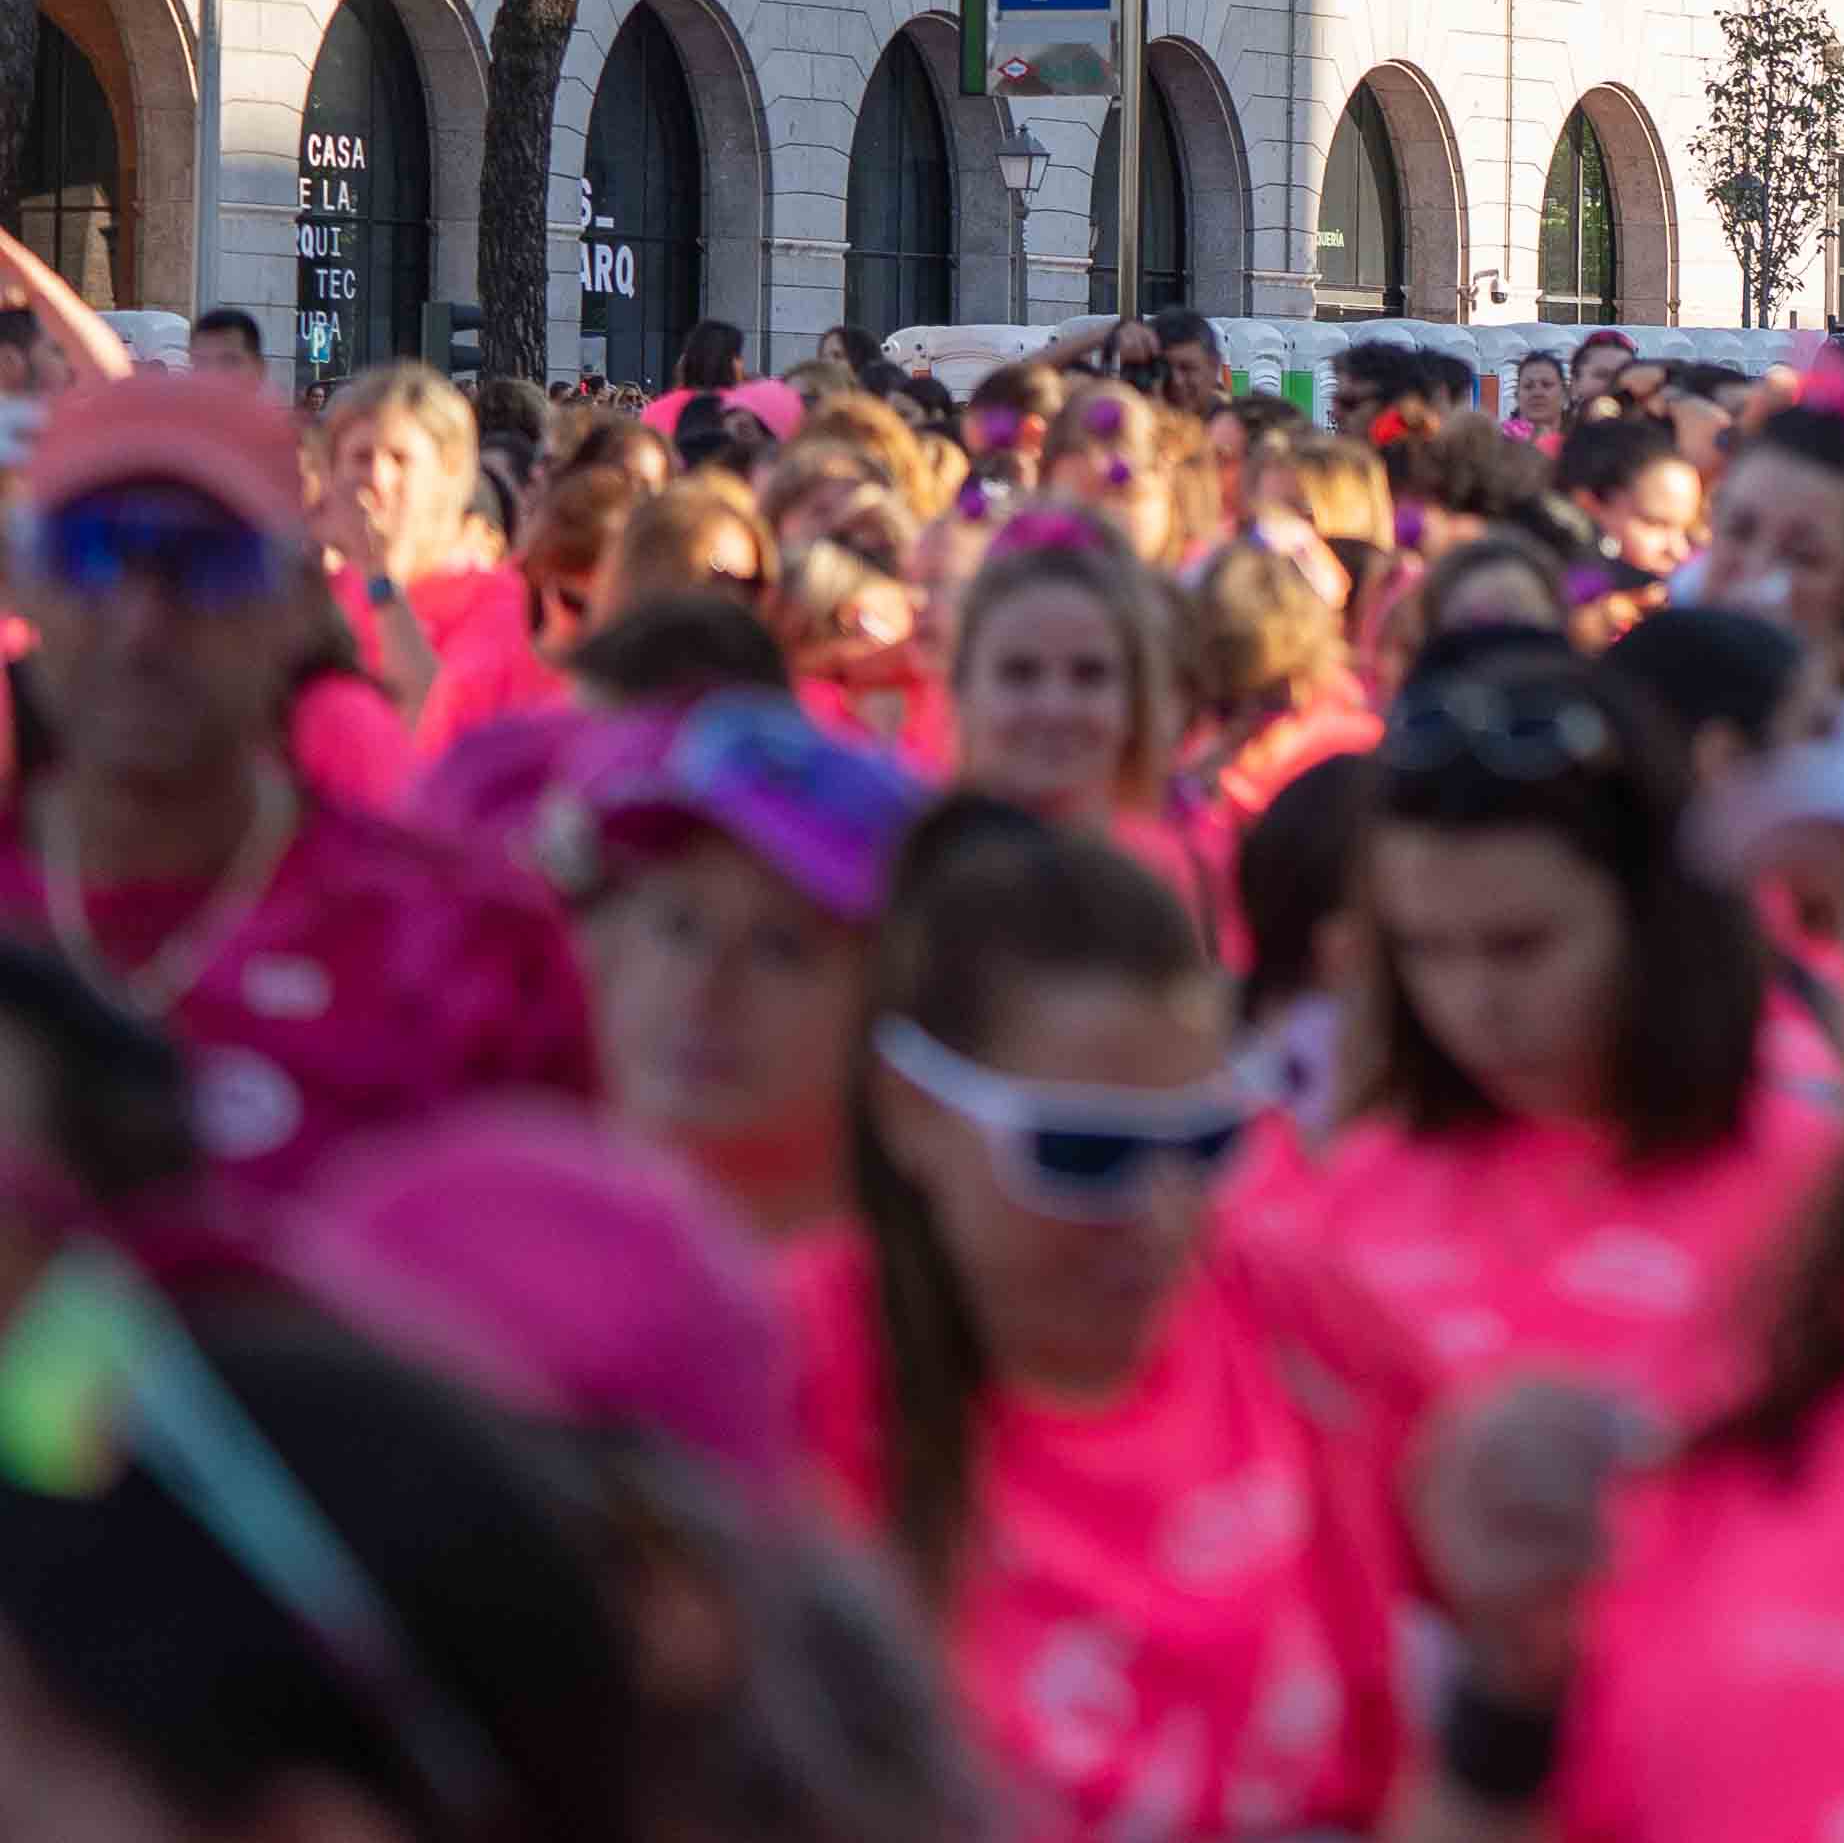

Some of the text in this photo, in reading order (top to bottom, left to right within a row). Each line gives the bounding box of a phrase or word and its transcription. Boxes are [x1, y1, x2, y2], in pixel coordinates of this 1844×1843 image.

[308, 133, 366, 170] CASA
[323, 179, 351, 211] LA
[315, 268, 357, 300] TEC
